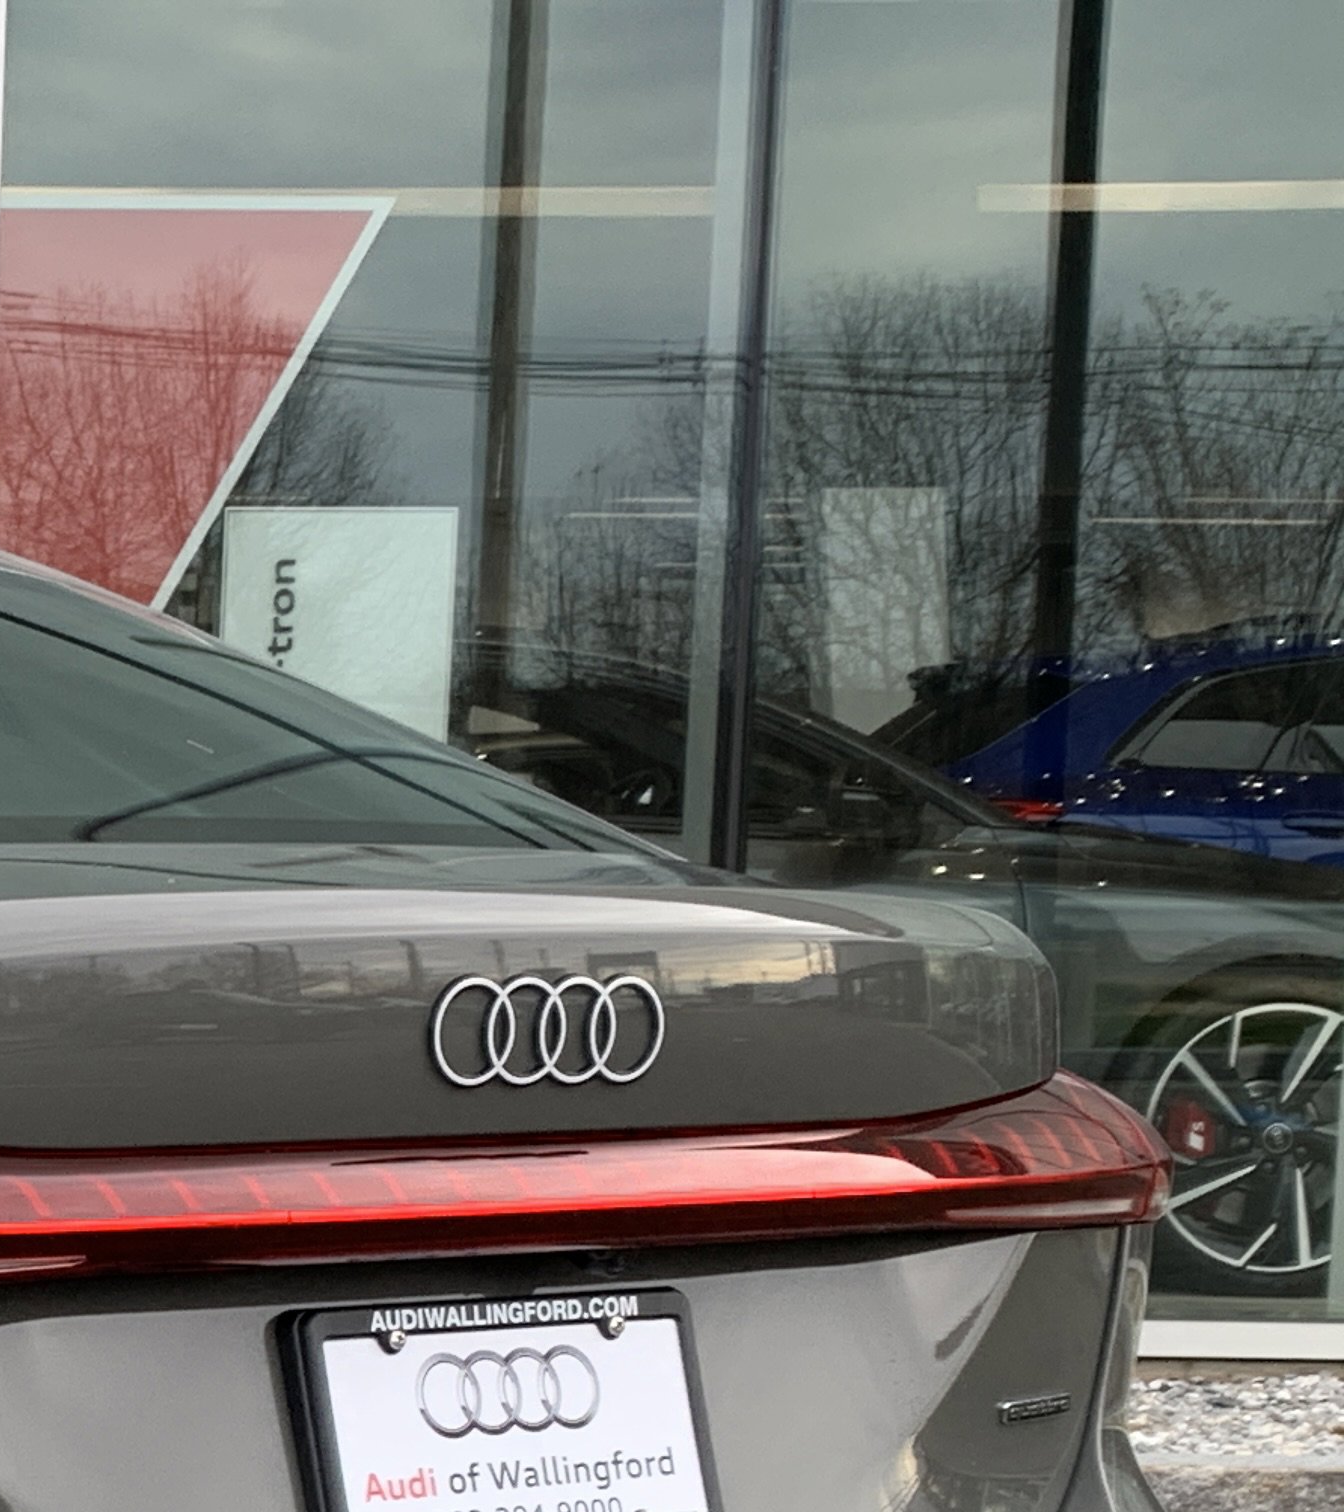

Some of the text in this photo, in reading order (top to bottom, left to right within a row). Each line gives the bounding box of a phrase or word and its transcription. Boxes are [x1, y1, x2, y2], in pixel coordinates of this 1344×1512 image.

[370, 1295, 639, 1333] AUDIWALLINGFORD.COM
[365, 1446, 676, 1503] Audi of Wallingford
